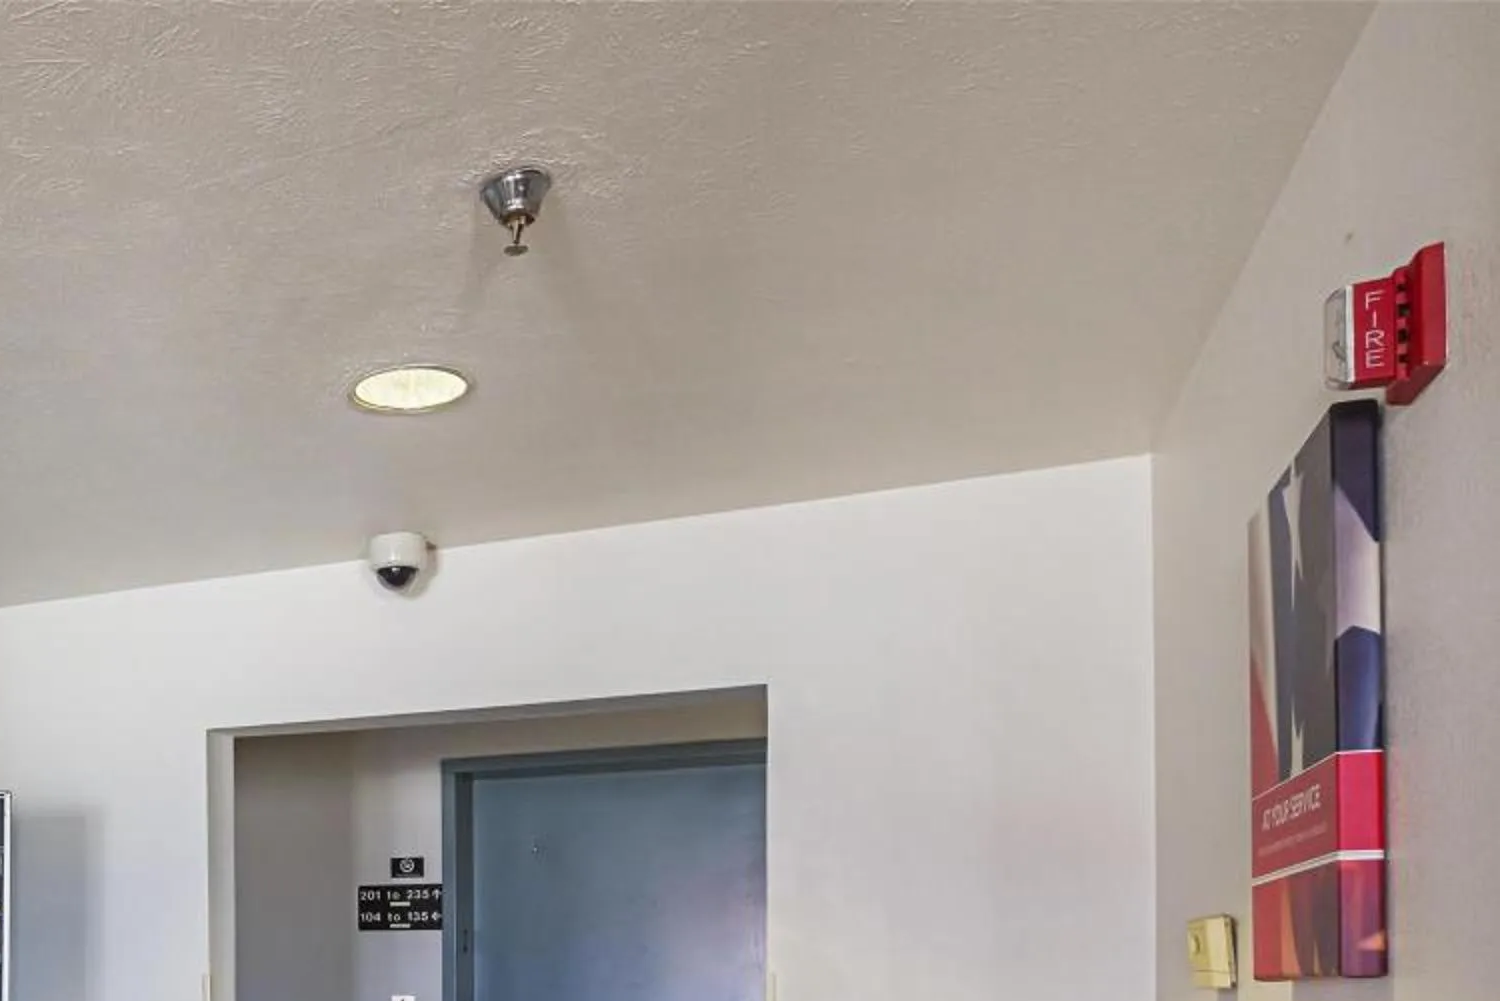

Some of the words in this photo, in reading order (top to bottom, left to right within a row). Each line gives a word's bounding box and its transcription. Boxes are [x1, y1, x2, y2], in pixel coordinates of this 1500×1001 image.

[1364, 288, 1387, 369] FIRE
[360, 889, 381, 901] 201
[386, 890, 401, 901] to
[360, 911, 381, 922] 104
[387, 911, 401, 922] to
[407, 911, 429, 922] 135
